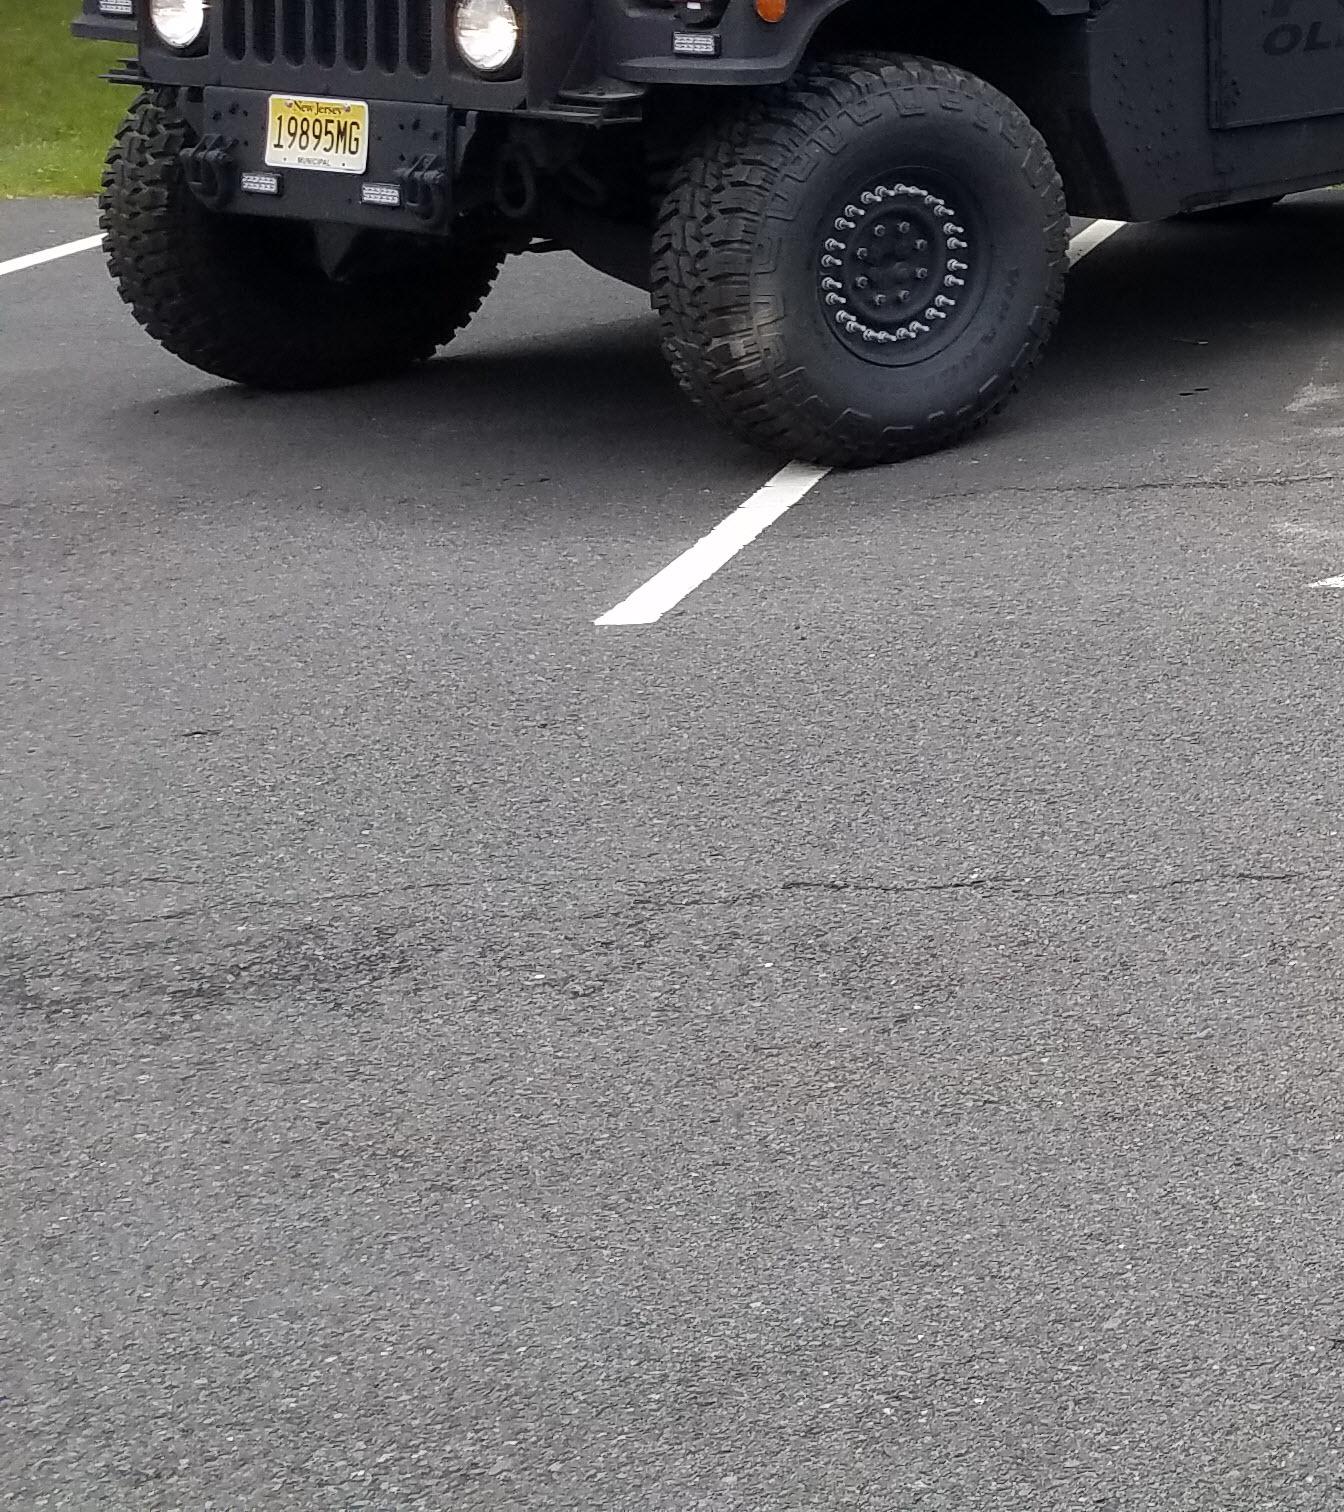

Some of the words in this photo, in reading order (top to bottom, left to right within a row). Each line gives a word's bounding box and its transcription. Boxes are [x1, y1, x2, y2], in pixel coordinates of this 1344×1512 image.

[293, 100, 314, 113] New
[314, 102, 342, 116] Jersey
[273, 114, 361, 155] 19895MG
